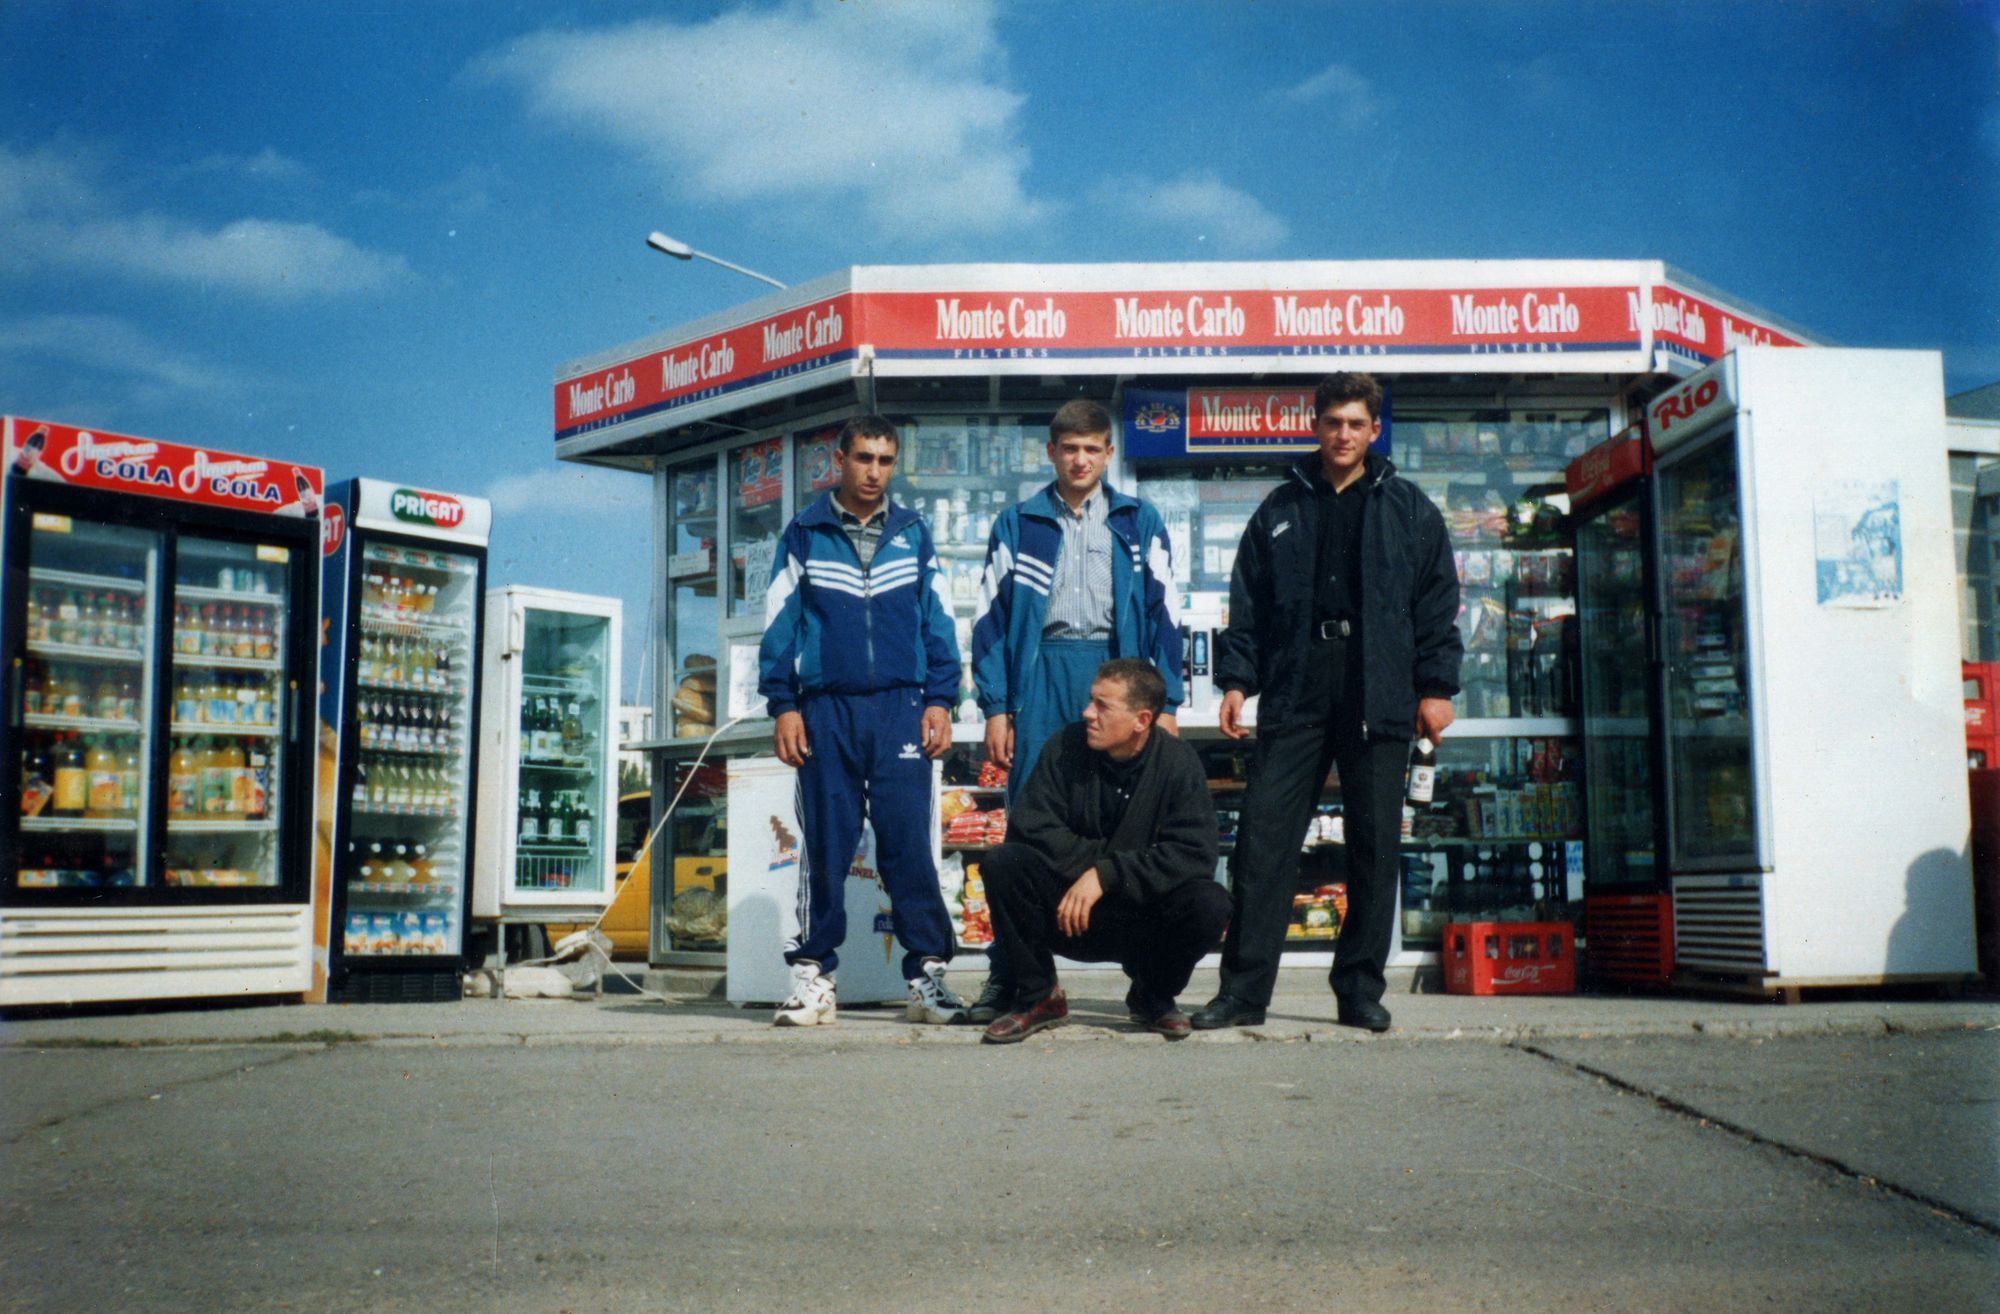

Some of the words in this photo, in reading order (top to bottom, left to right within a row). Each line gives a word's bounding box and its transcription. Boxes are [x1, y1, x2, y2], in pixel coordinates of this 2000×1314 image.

[935, 299, 1004, 339] Monte
[1008, 297, 1066, 339] Carlo
[1115, 298, 1182, 338] Monte
[1187, 296, 1245, 337] Carlo
[1273, 296, 1342, 336] Monte
[1346, 295, 1404, 335] Carlo
[1450, 294, 1518, 334] Monte
[1522, 292, 1579, 333] Carlo
[762, 321, 803, 363] Monte
[805, 305, 843, 351] Carlo
[1133, 347, 1228, 357] FILTERS
[1293, 345, 1388, 355] FILTERS
[1471, 343, 1564, 353] FILTERS
[661, 355, 699, 392] Monte
[700, 339, 735, 380] Carlo
[954, 349, 1048, 359] FILTERS
[569, 383, 604, 419] Monte
[605, 368, 636, 408] Carlo
[1653, 379, 1719, 431] Rio
[1201, 396, 1262, 433] Monte
[96, 459, 174, 488] COLA
[211, 478, 282, 503] COLA
[394, 493, 461, 522] PRIGAT
